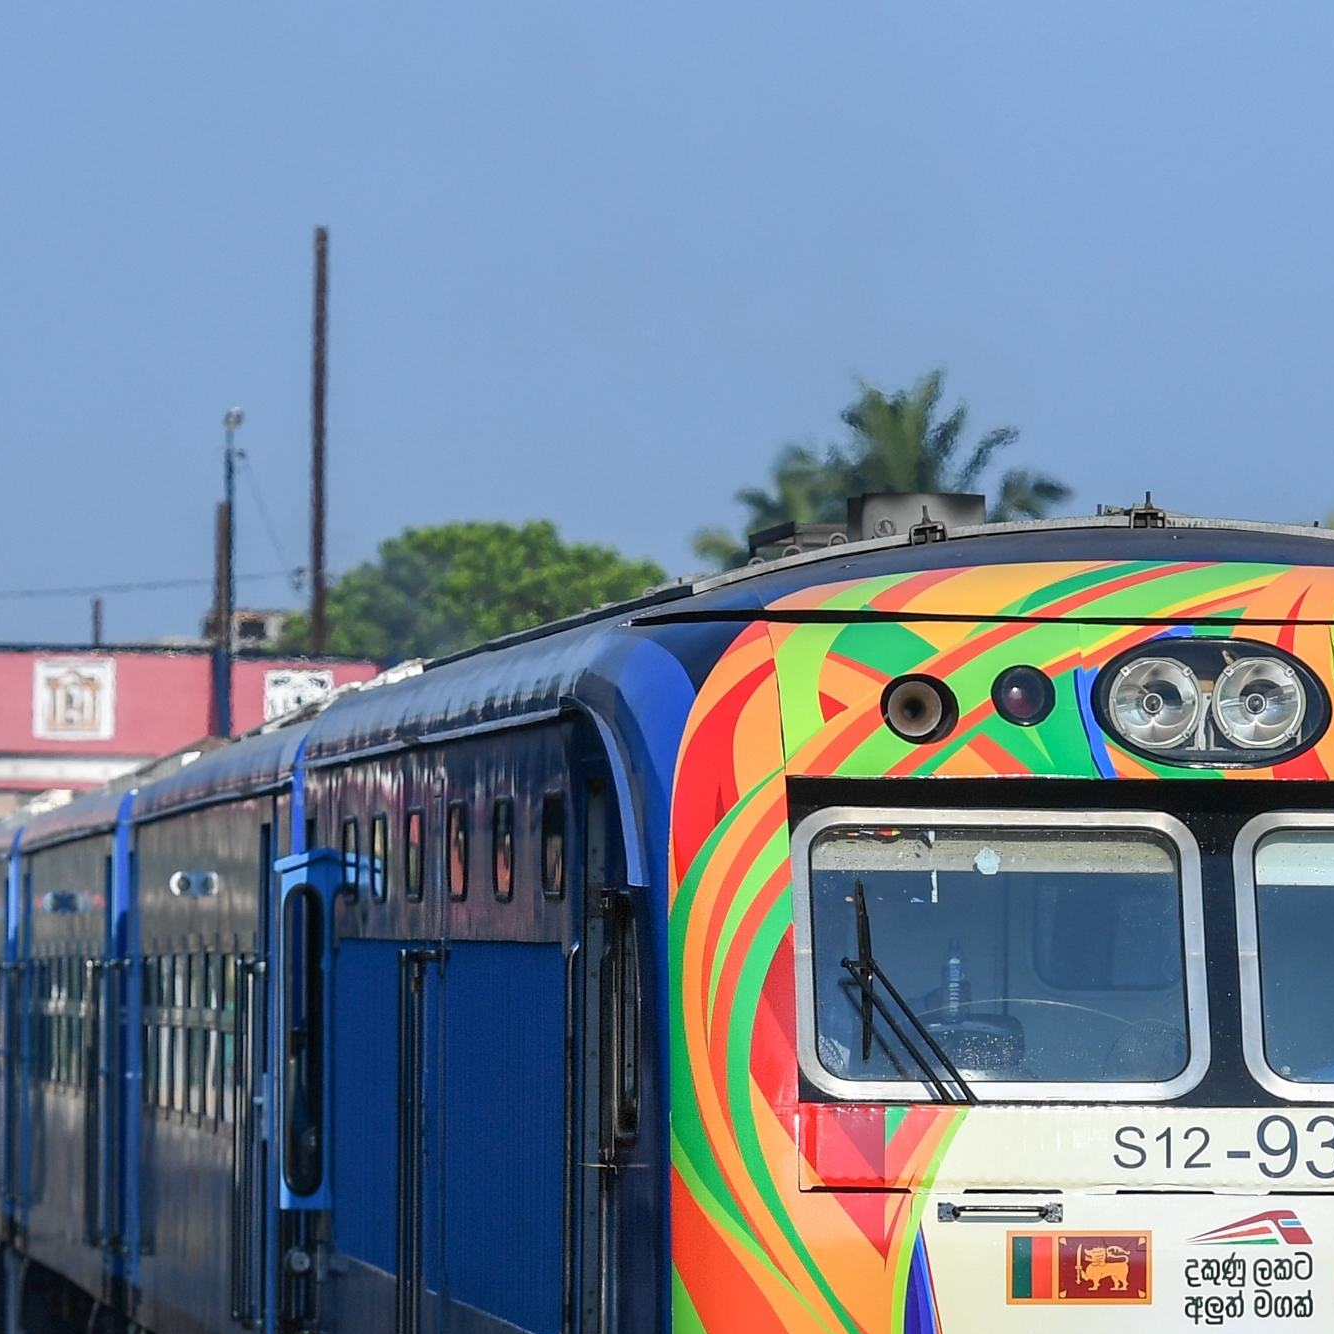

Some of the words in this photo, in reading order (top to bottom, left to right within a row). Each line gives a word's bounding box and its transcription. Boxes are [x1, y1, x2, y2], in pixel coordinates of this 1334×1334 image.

[1184, 1251, 1246, 1287] දකුණු
[1253, 1251, 1313, 1287] ලකට
[1184, 1289, 1244, 1325] අලුත්
[1254, 1289, 1313, 1318] මගක්
